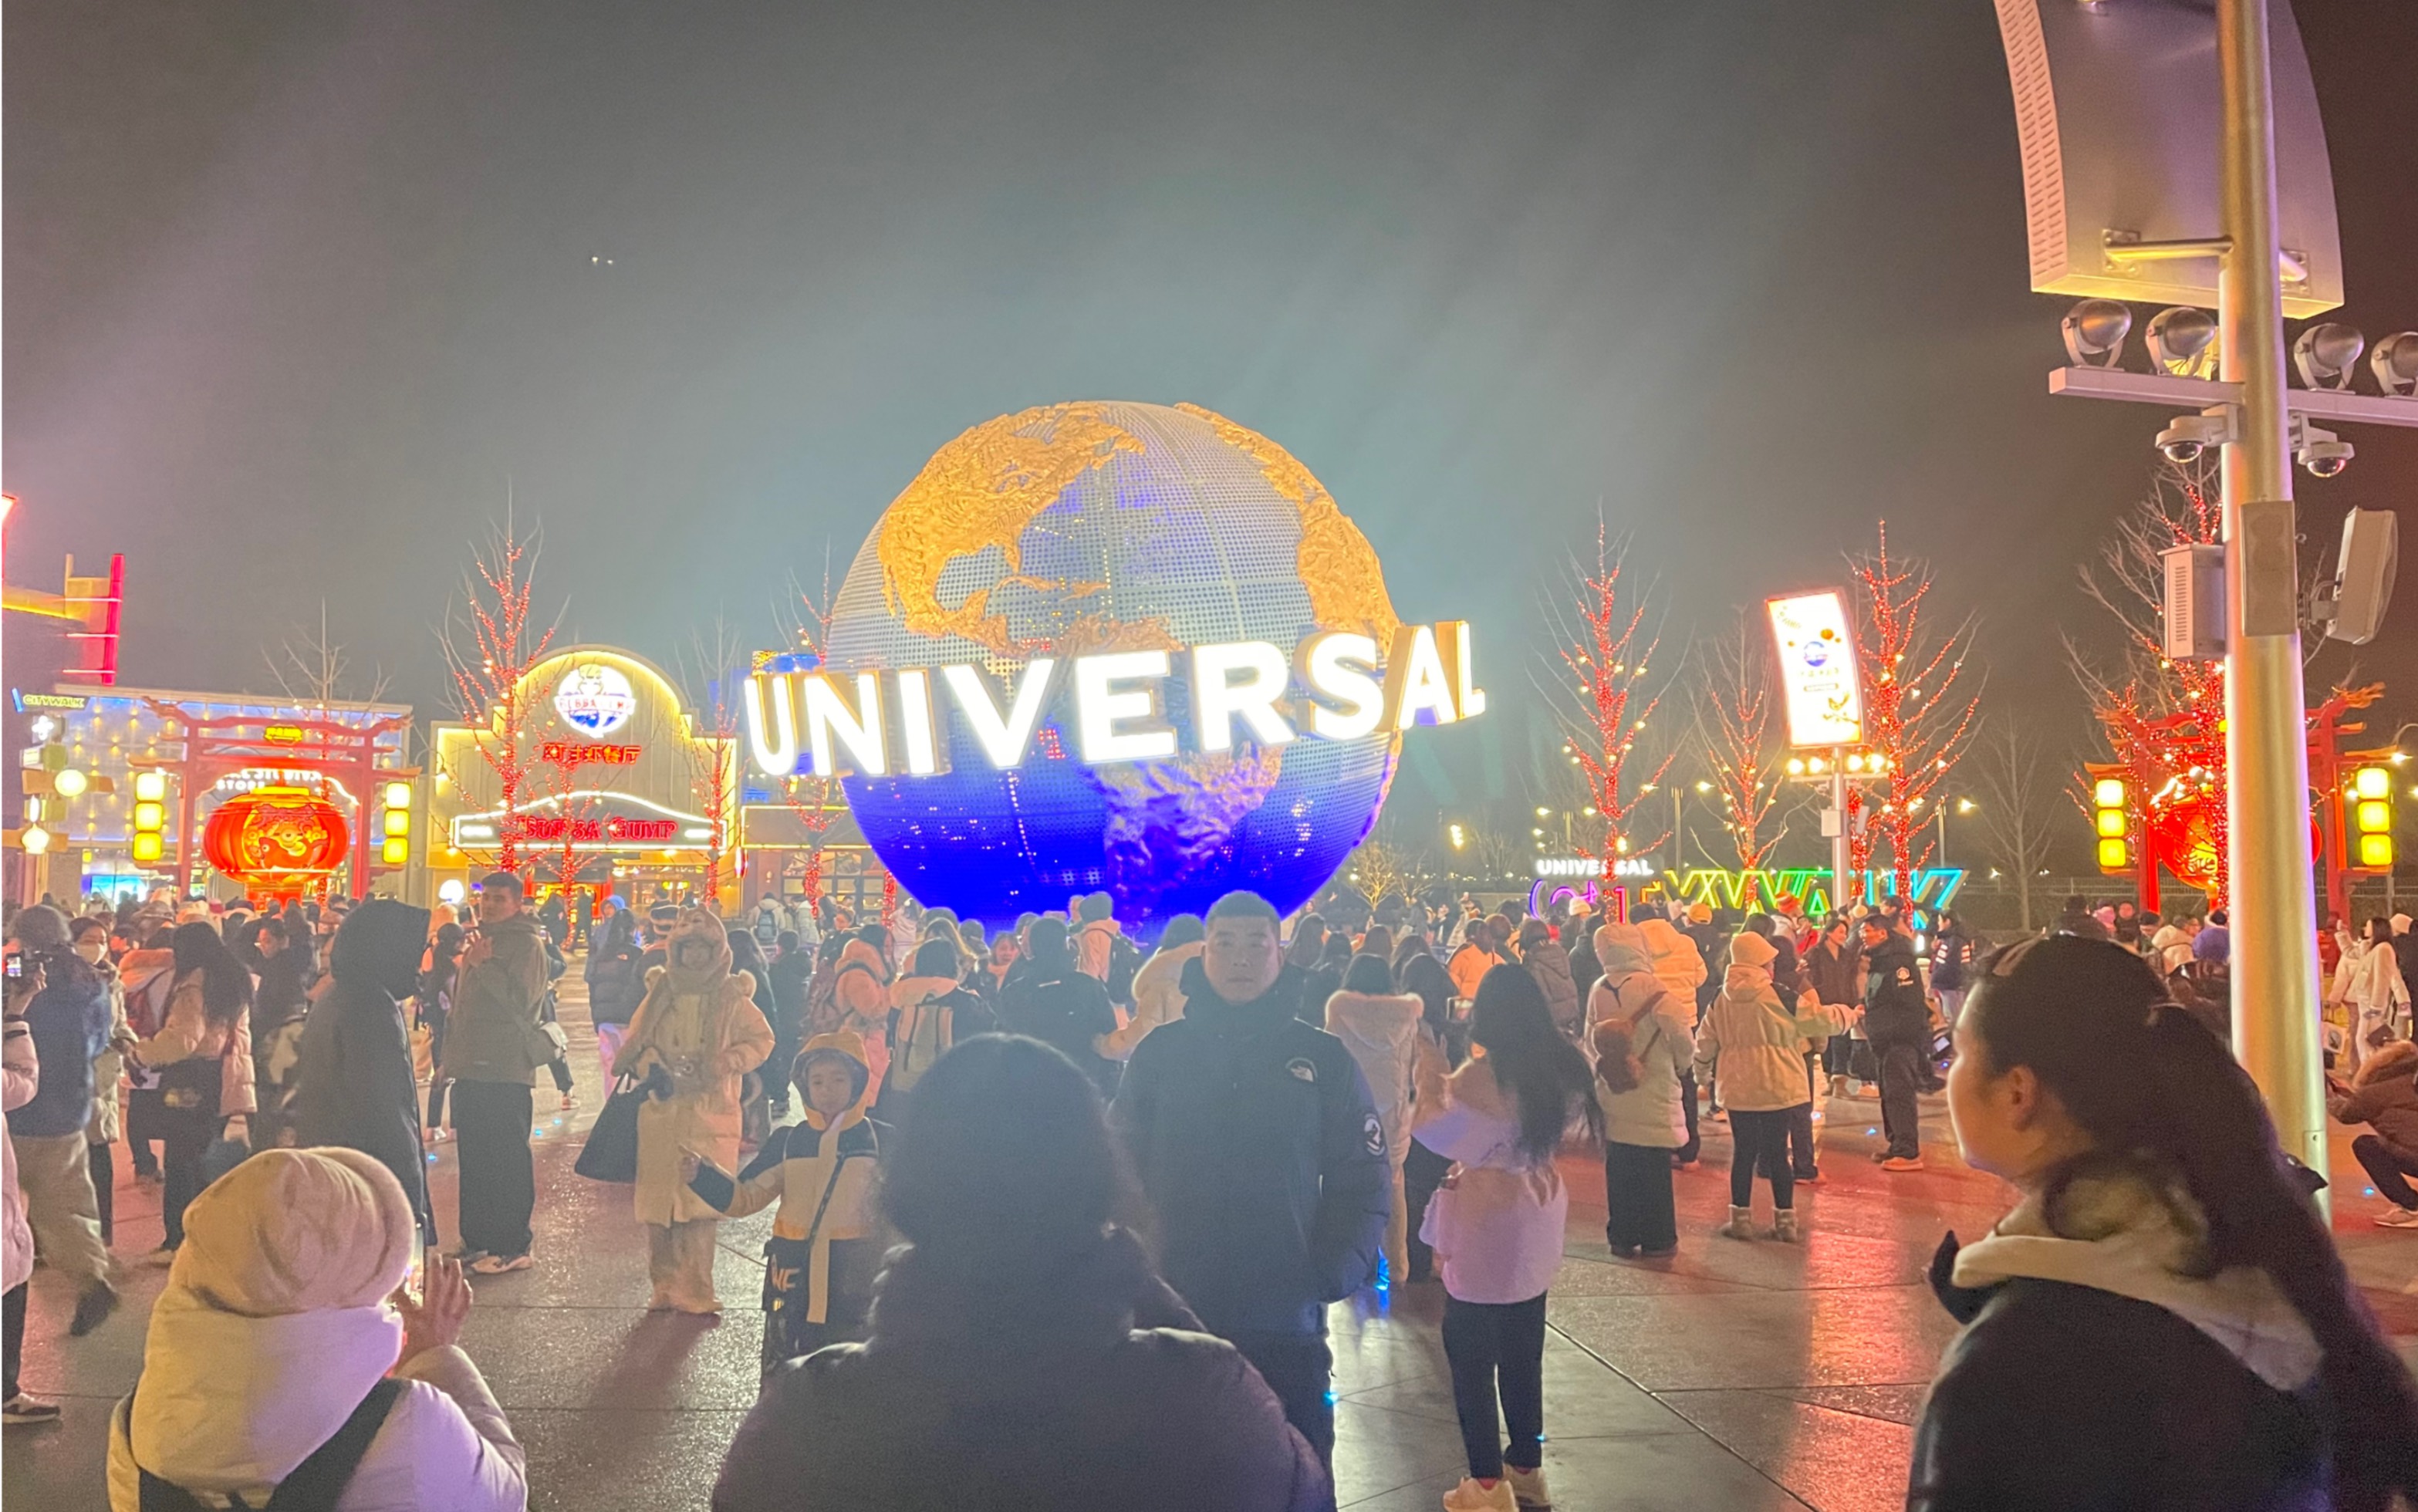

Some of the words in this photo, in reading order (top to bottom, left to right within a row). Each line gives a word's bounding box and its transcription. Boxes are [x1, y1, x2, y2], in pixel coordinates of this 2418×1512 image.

[23, 694, 85, 709] CITYWALK
[744, 620, 1486, 776] UNIVERSAL
[607, 816, 678, 841] GUMP
